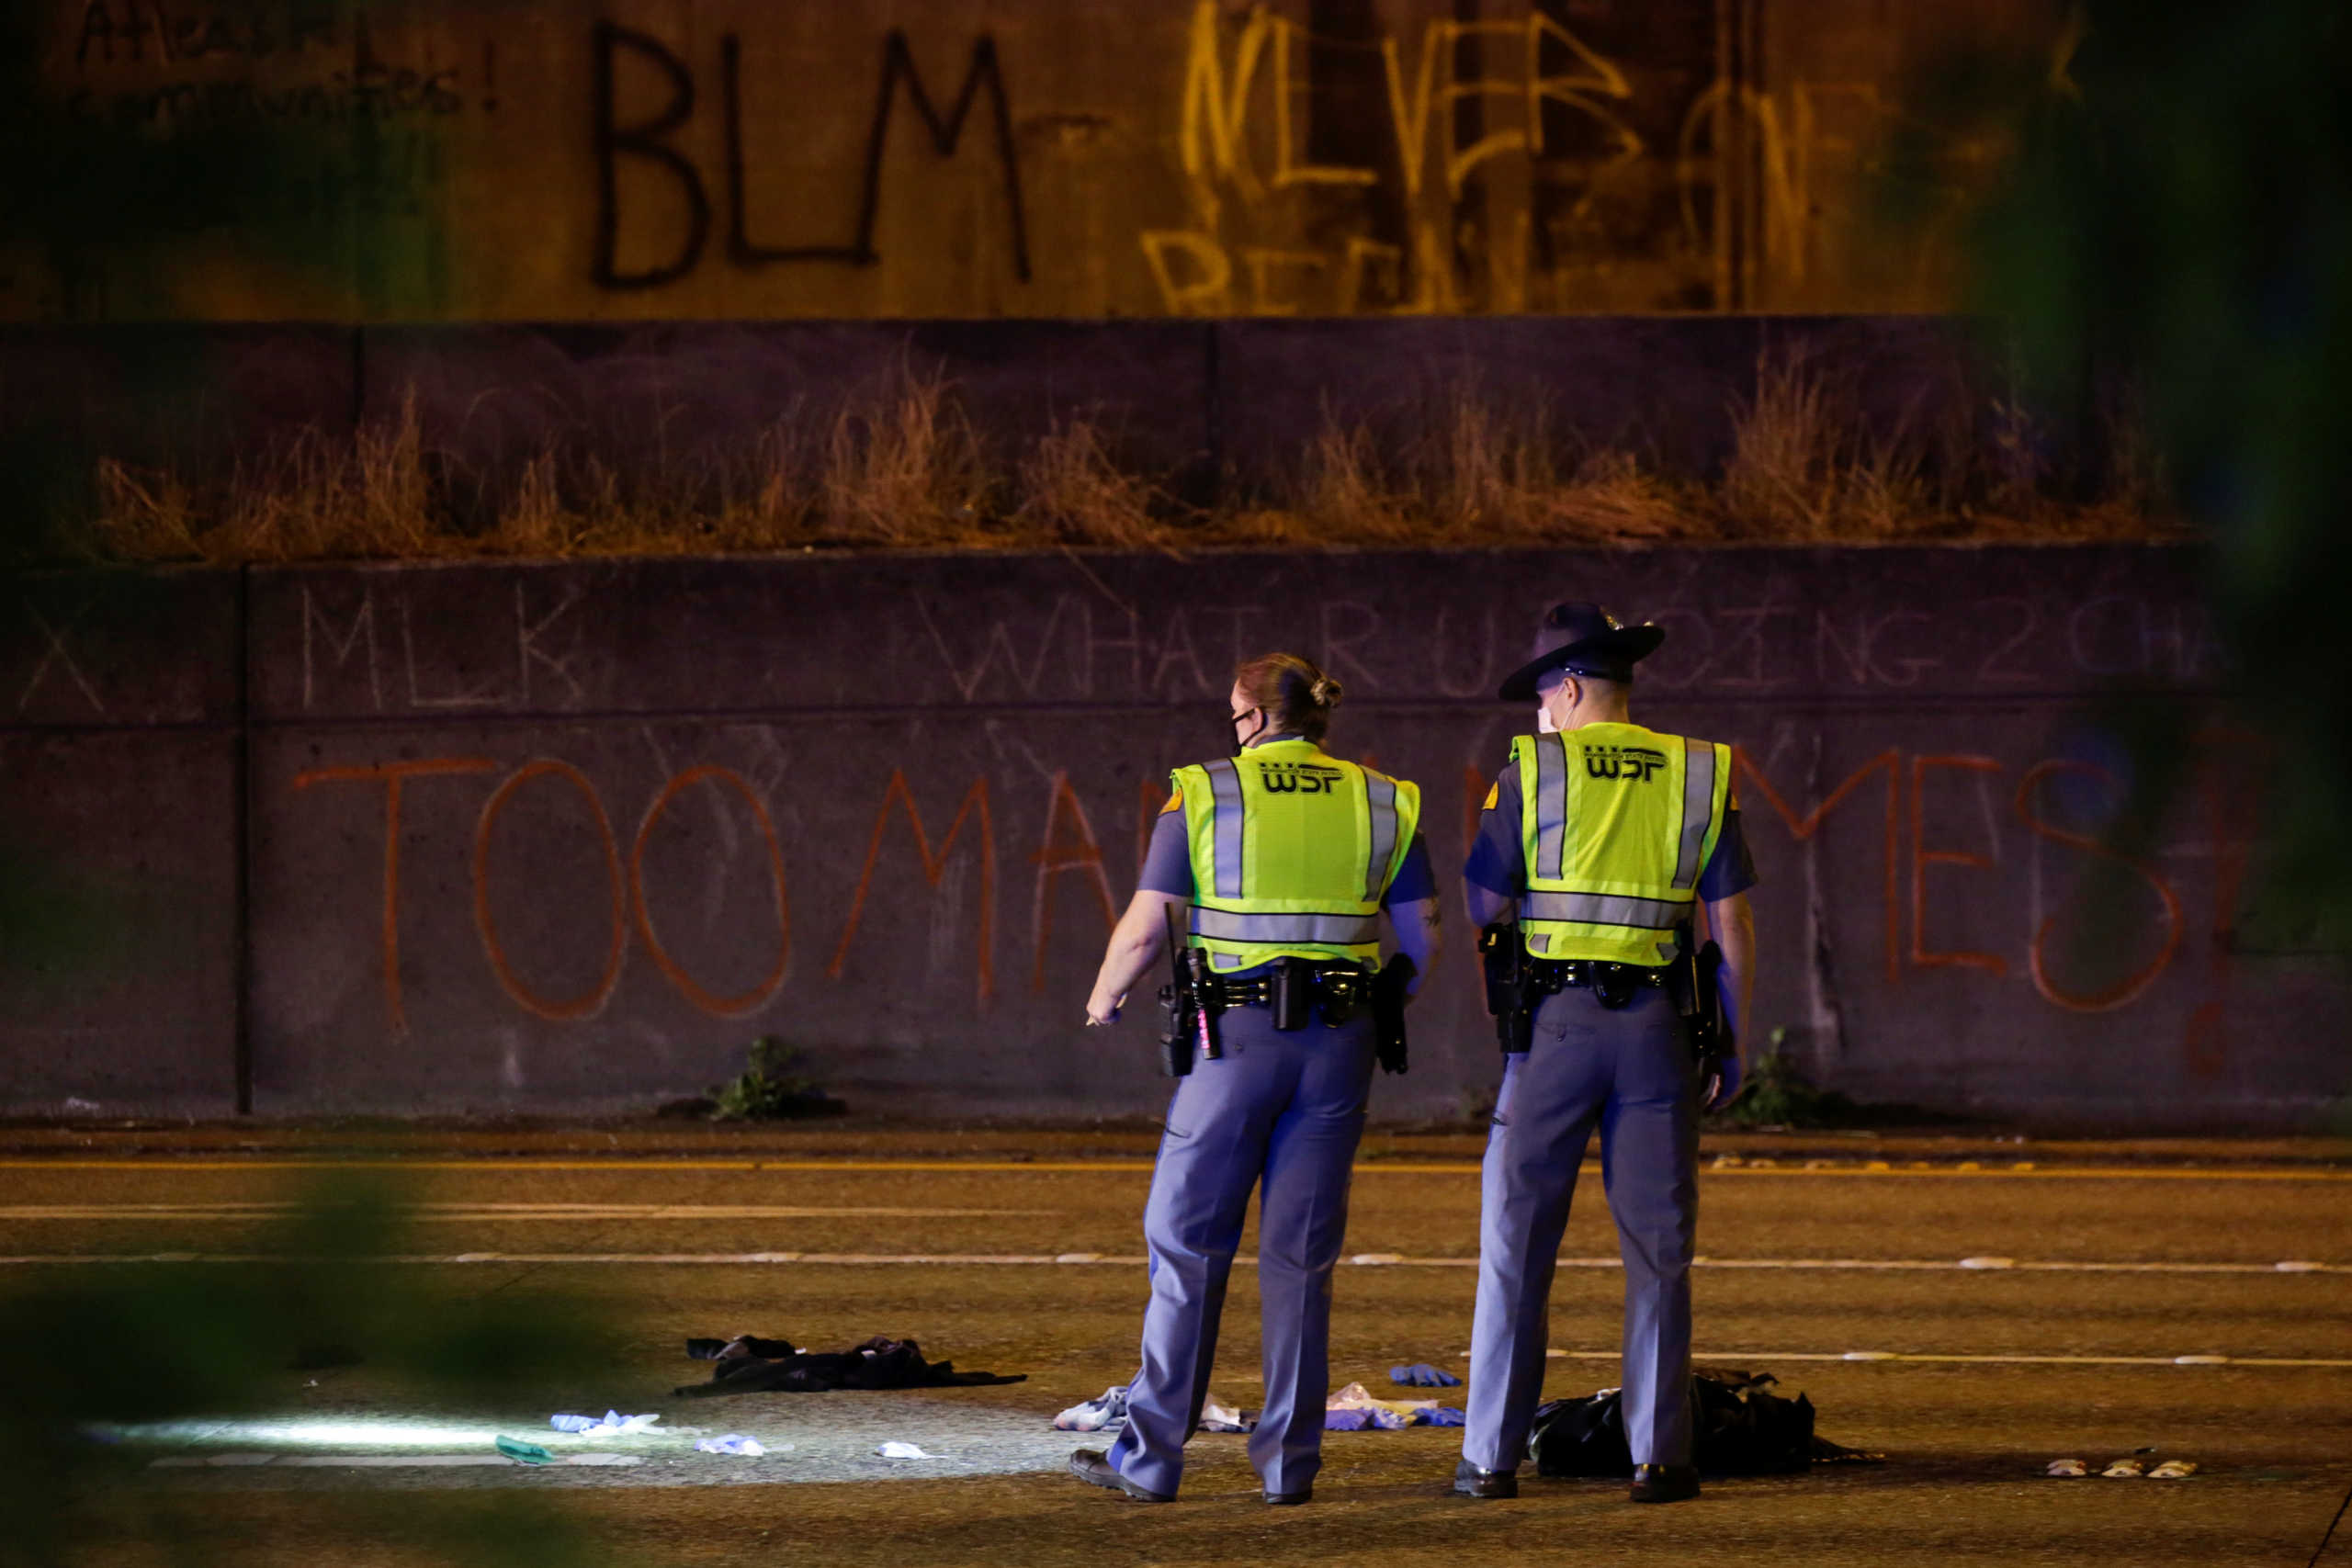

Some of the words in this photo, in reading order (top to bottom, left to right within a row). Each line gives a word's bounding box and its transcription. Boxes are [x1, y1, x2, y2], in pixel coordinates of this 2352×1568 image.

[595, 20, 1031, 290] BLM
[301, 581, 586, 711] MLK
[1640, 591, 1937, 689] OING
[294, 756, 792, 1044] TOO
[831, 770, 1171, 1007] MA
